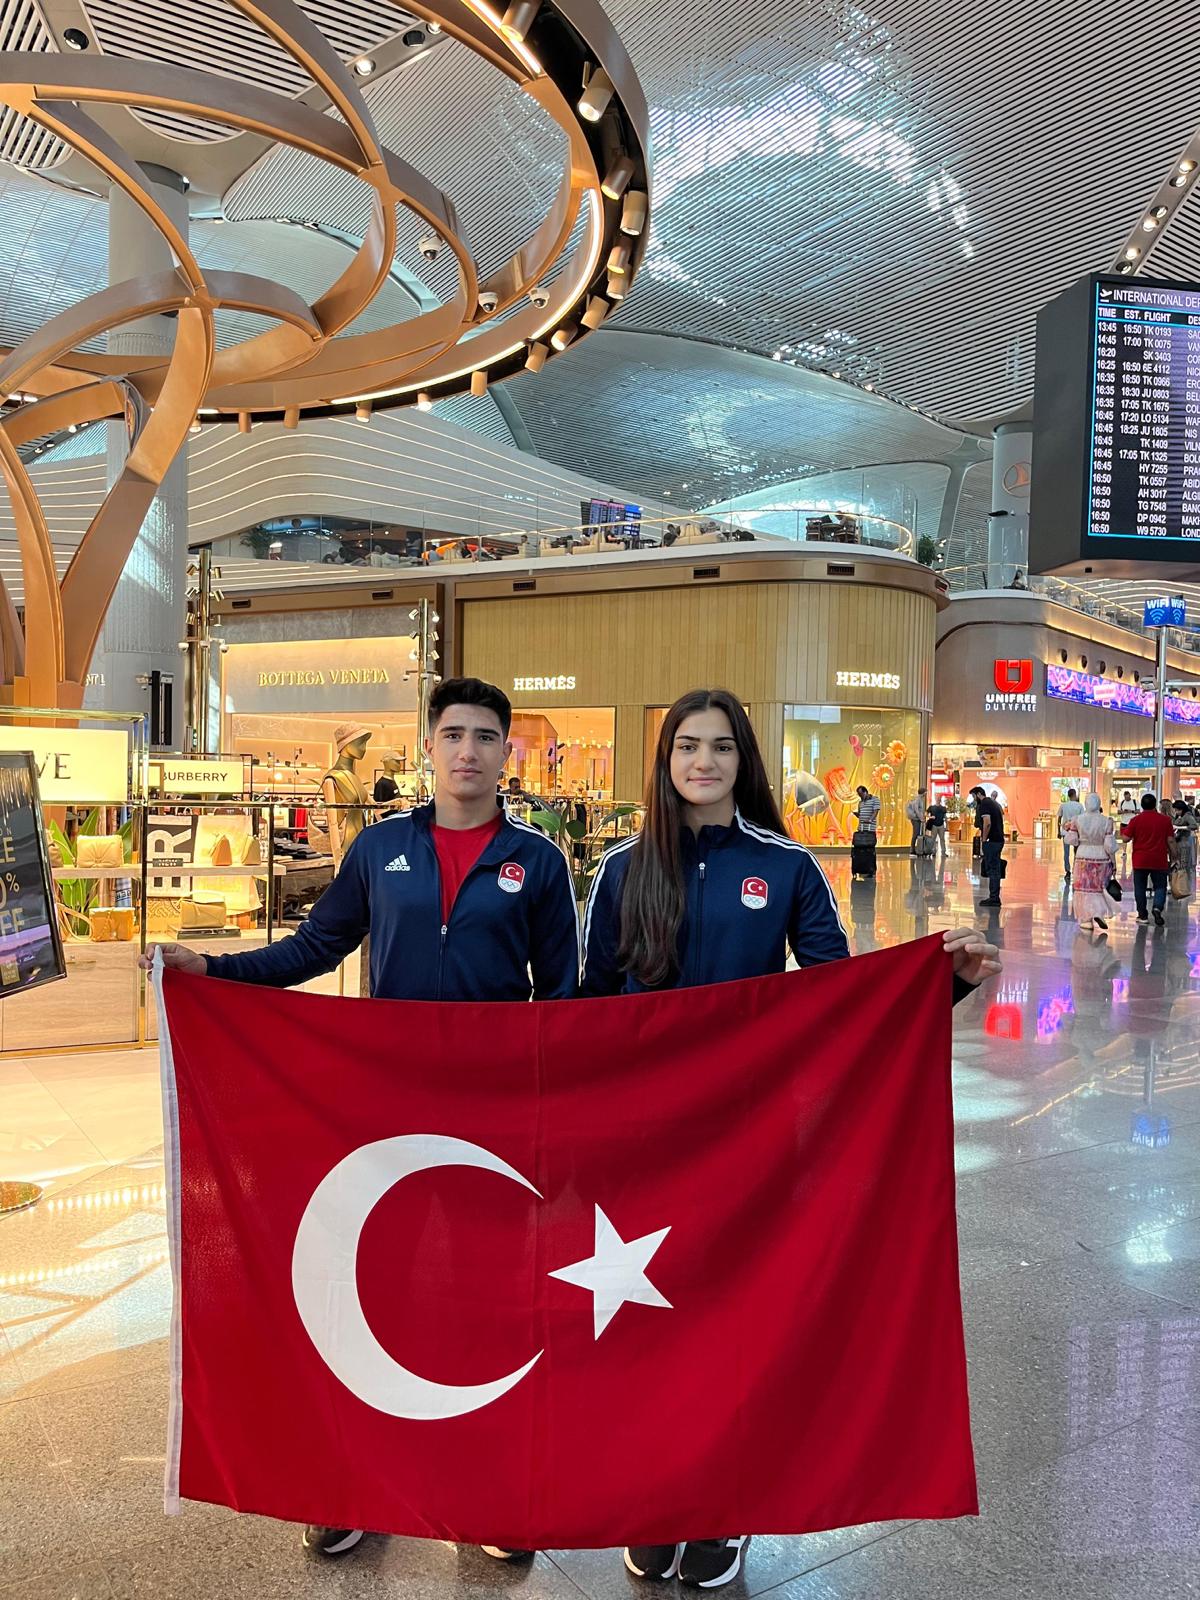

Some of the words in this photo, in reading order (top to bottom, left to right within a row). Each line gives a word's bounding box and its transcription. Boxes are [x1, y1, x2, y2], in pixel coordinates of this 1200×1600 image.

[1113, 290, 1184, 306] INTERNATIONAL
[1098, 308, 1116, 318] TIME
[1124, 310, 1141, 320] EST.
[1144, 312, 1171, 322] FLIGHT
[1098, 322, 1116, 332] 13:45
[1124, 324, 1142, 334] 16:50
[1144, 326, 1154, 335] TK
[1098, 334, 1116, 345] 14:45
[1123, 337, 1141, 346] 17:00
[1144, 338, 1154, 348] TK
[1098, 347, 1116, 357] 16:20
[1143, 351, 1154, 360] SK
[1097, 360, 1116, 370] 16:25
[1123, 362, 1141, 372] 16:50
[1142, 363, 1152, 373] 6E
[1153, 364, 1170, 374] 4112
[1097, 372, 1115, 383] 16:35
[1142, 376, 1153, 385] TK
[1096, 385, 1115, 395] 16:35
[1142, 389, 1151, 398] JU
[1121, 400, 1139, 409] 17:05
[1141, 401, 1152, 410] TK
[1095, 410, 1114, 420] 16:45
[1121, 412, 1139, 422] 17:20
[1141, 414, 1152, 423] LO
[1153, 414, 1169, 424] 5134
[1095, 423, 1113, 433] 16:45
[1140, 426, 1150, 435] JU
[1185, 429, 1198, 438] NIS
[1094, 436, 1113, 446] 16:45
[1140, 438, 1150, 448] TK
[1094, 448, 1112, 458] 16:45
[1119, 450, 1138, 460] 17:05
[1140, 451, 1150, 460] TK
[1093, 461, 1112, 471] 16:45
[1139, 463, 1150, 473] HY
[1151, 464, 1168, 474] 7255
[1093, 473, 1112, 483] 16:50
[1139, 476, 1149, 485] TK
[1092, 486, 1111, 496] 16:50
[1138, 488, 1149, 498] AH
[1150, 489, 1167, 499] 3017
[1092, 498, 1110, 508] 16:50
[1138, 501, 1148, 510] TG
[1091, 511, 1110, 521] 16:50
[1137, 513, 1148, 523] DP
[1091, 524, 1110, 533] 16:50
[1137, 526, 1148, 535] W9
[258, 670, 325, 686] BOTTEGA
[329, 668, 390, 685] VENETA
[985, 694, 1037, 704] UNIFREE
